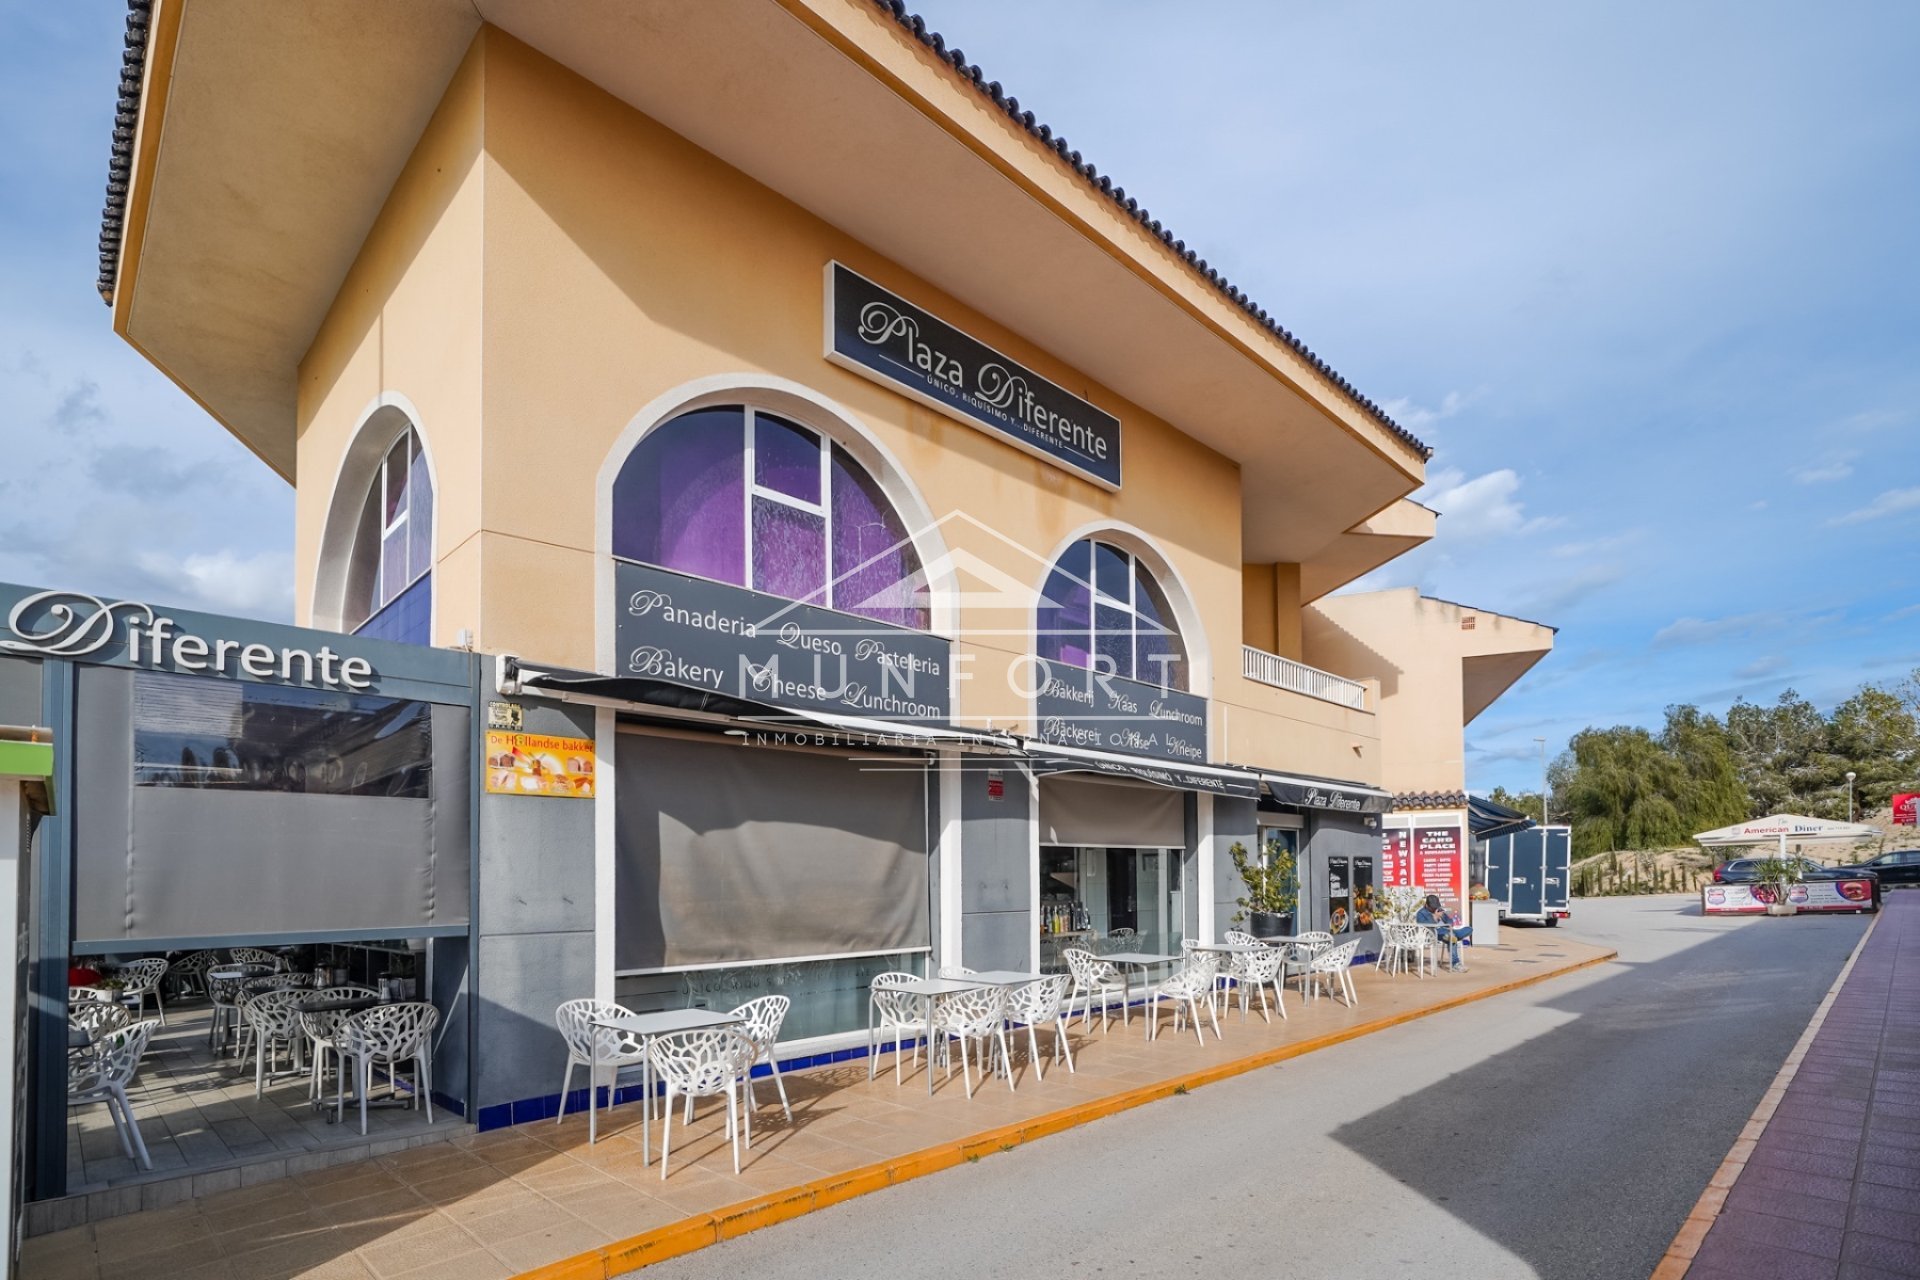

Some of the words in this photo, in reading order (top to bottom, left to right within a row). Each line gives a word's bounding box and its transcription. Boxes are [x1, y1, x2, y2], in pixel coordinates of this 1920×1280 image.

[858, 302, 963, 388] Plaza
[975, 362, 1107, 460] Diferente
[0, 590, 373, 689] Diferente
[629, 590, 757, 639] Panaderia
[776, 622, 842, 656] Queso
[855, 638, 941, 676] Pasteleria
[629, 646, 724, 689] Bakery
[747, 663, 827, 702] Cheese
[840, 682, 941, 721] Lunchroom
[1043, 677, 1094, 709] Bakkerij
[1108, 690, 1138, 714] Kaas
[1149, 699, 1203, 727] Lunchroom
[491, 735, 502, 744] De
[1167, 736, 1202, 760] Kneipe
[1743, 826, 1789, 835] American
[1794, 824, 1824, 833] Diner
